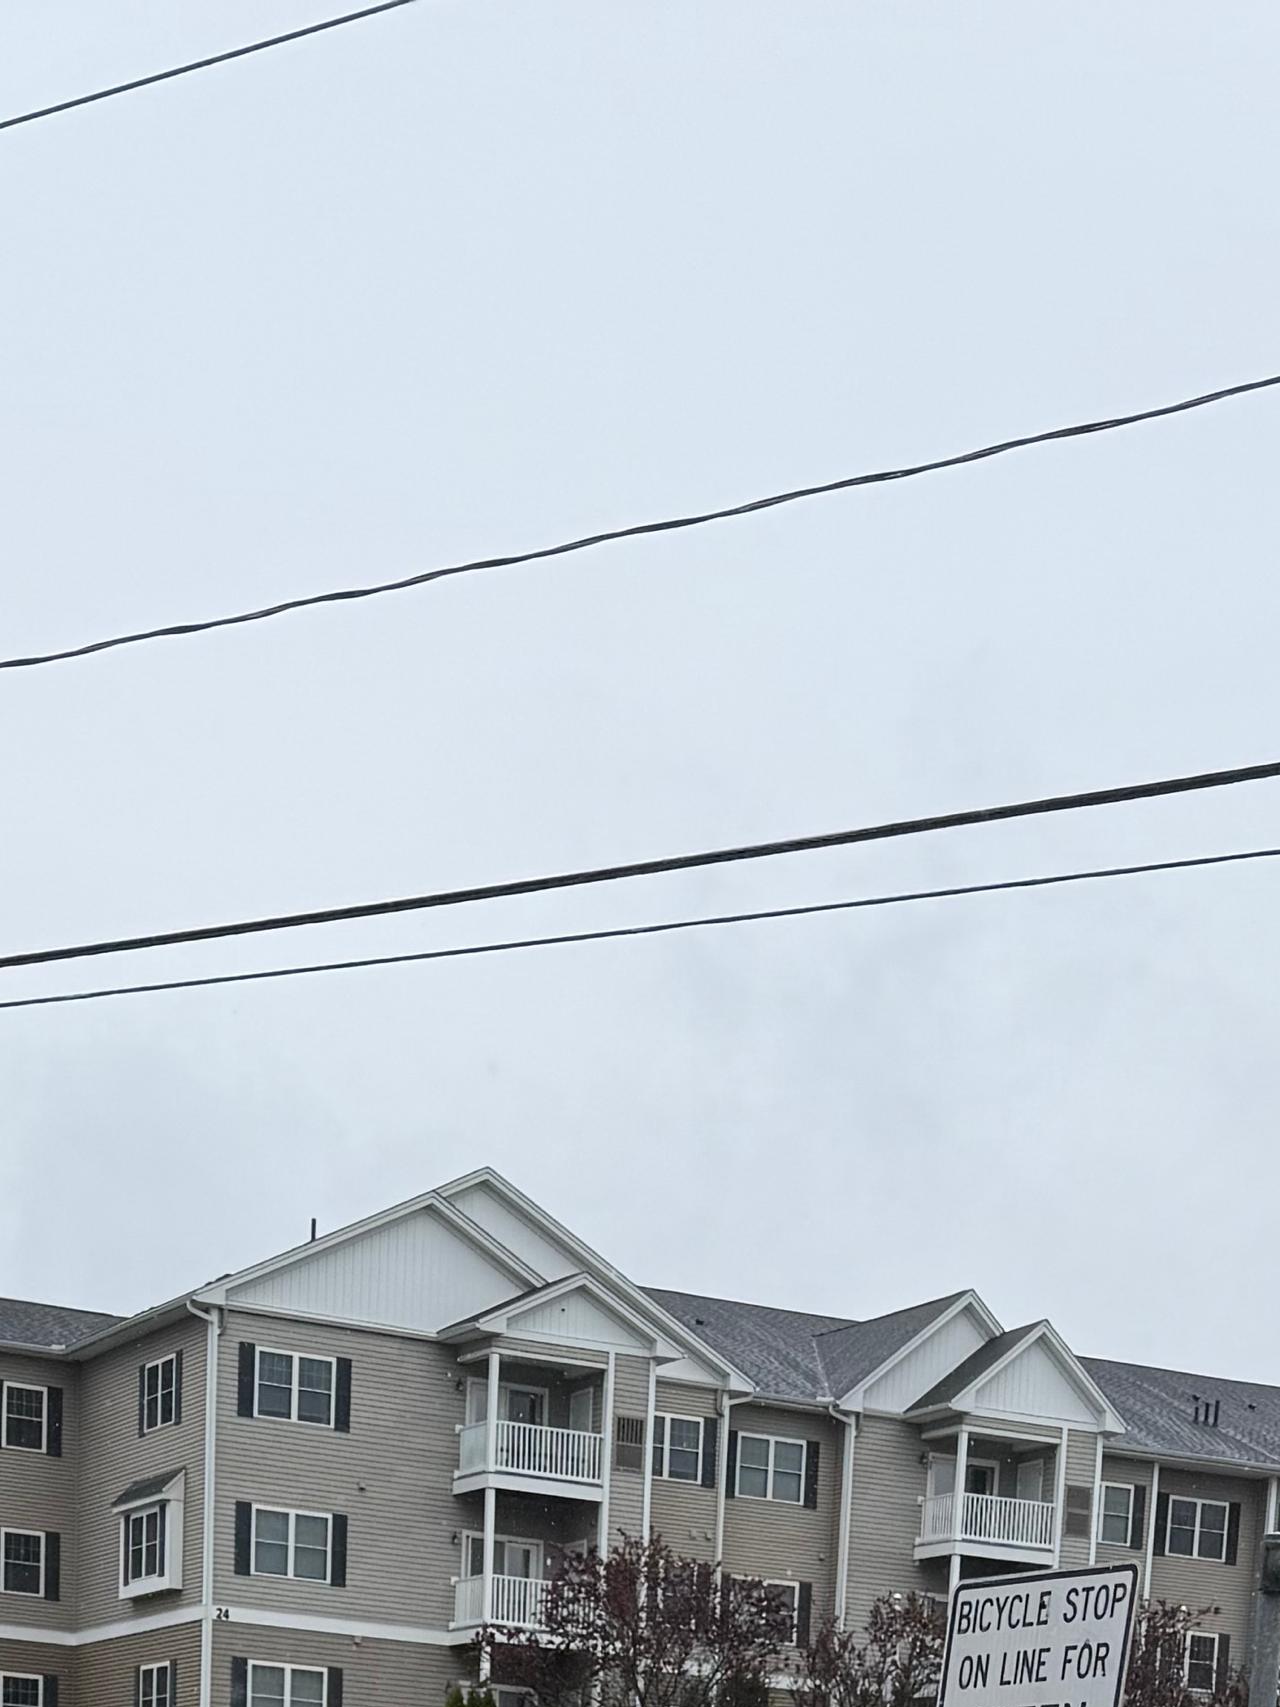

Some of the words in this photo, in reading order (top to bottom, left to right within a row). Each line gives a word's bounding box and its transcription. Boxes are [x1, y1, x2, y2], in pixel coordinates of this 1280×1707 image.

[216, 1608, 229, 1620] 24
[958, 1592, 1051, 1634] BICYCLE
[1064, 1583, 1126, 1623] STOP
[959, 1654, 990, 1690] ON
[1000, 1648, 1050, 1686] LINE
[1061, 1641, 1109, 1680] FOR
